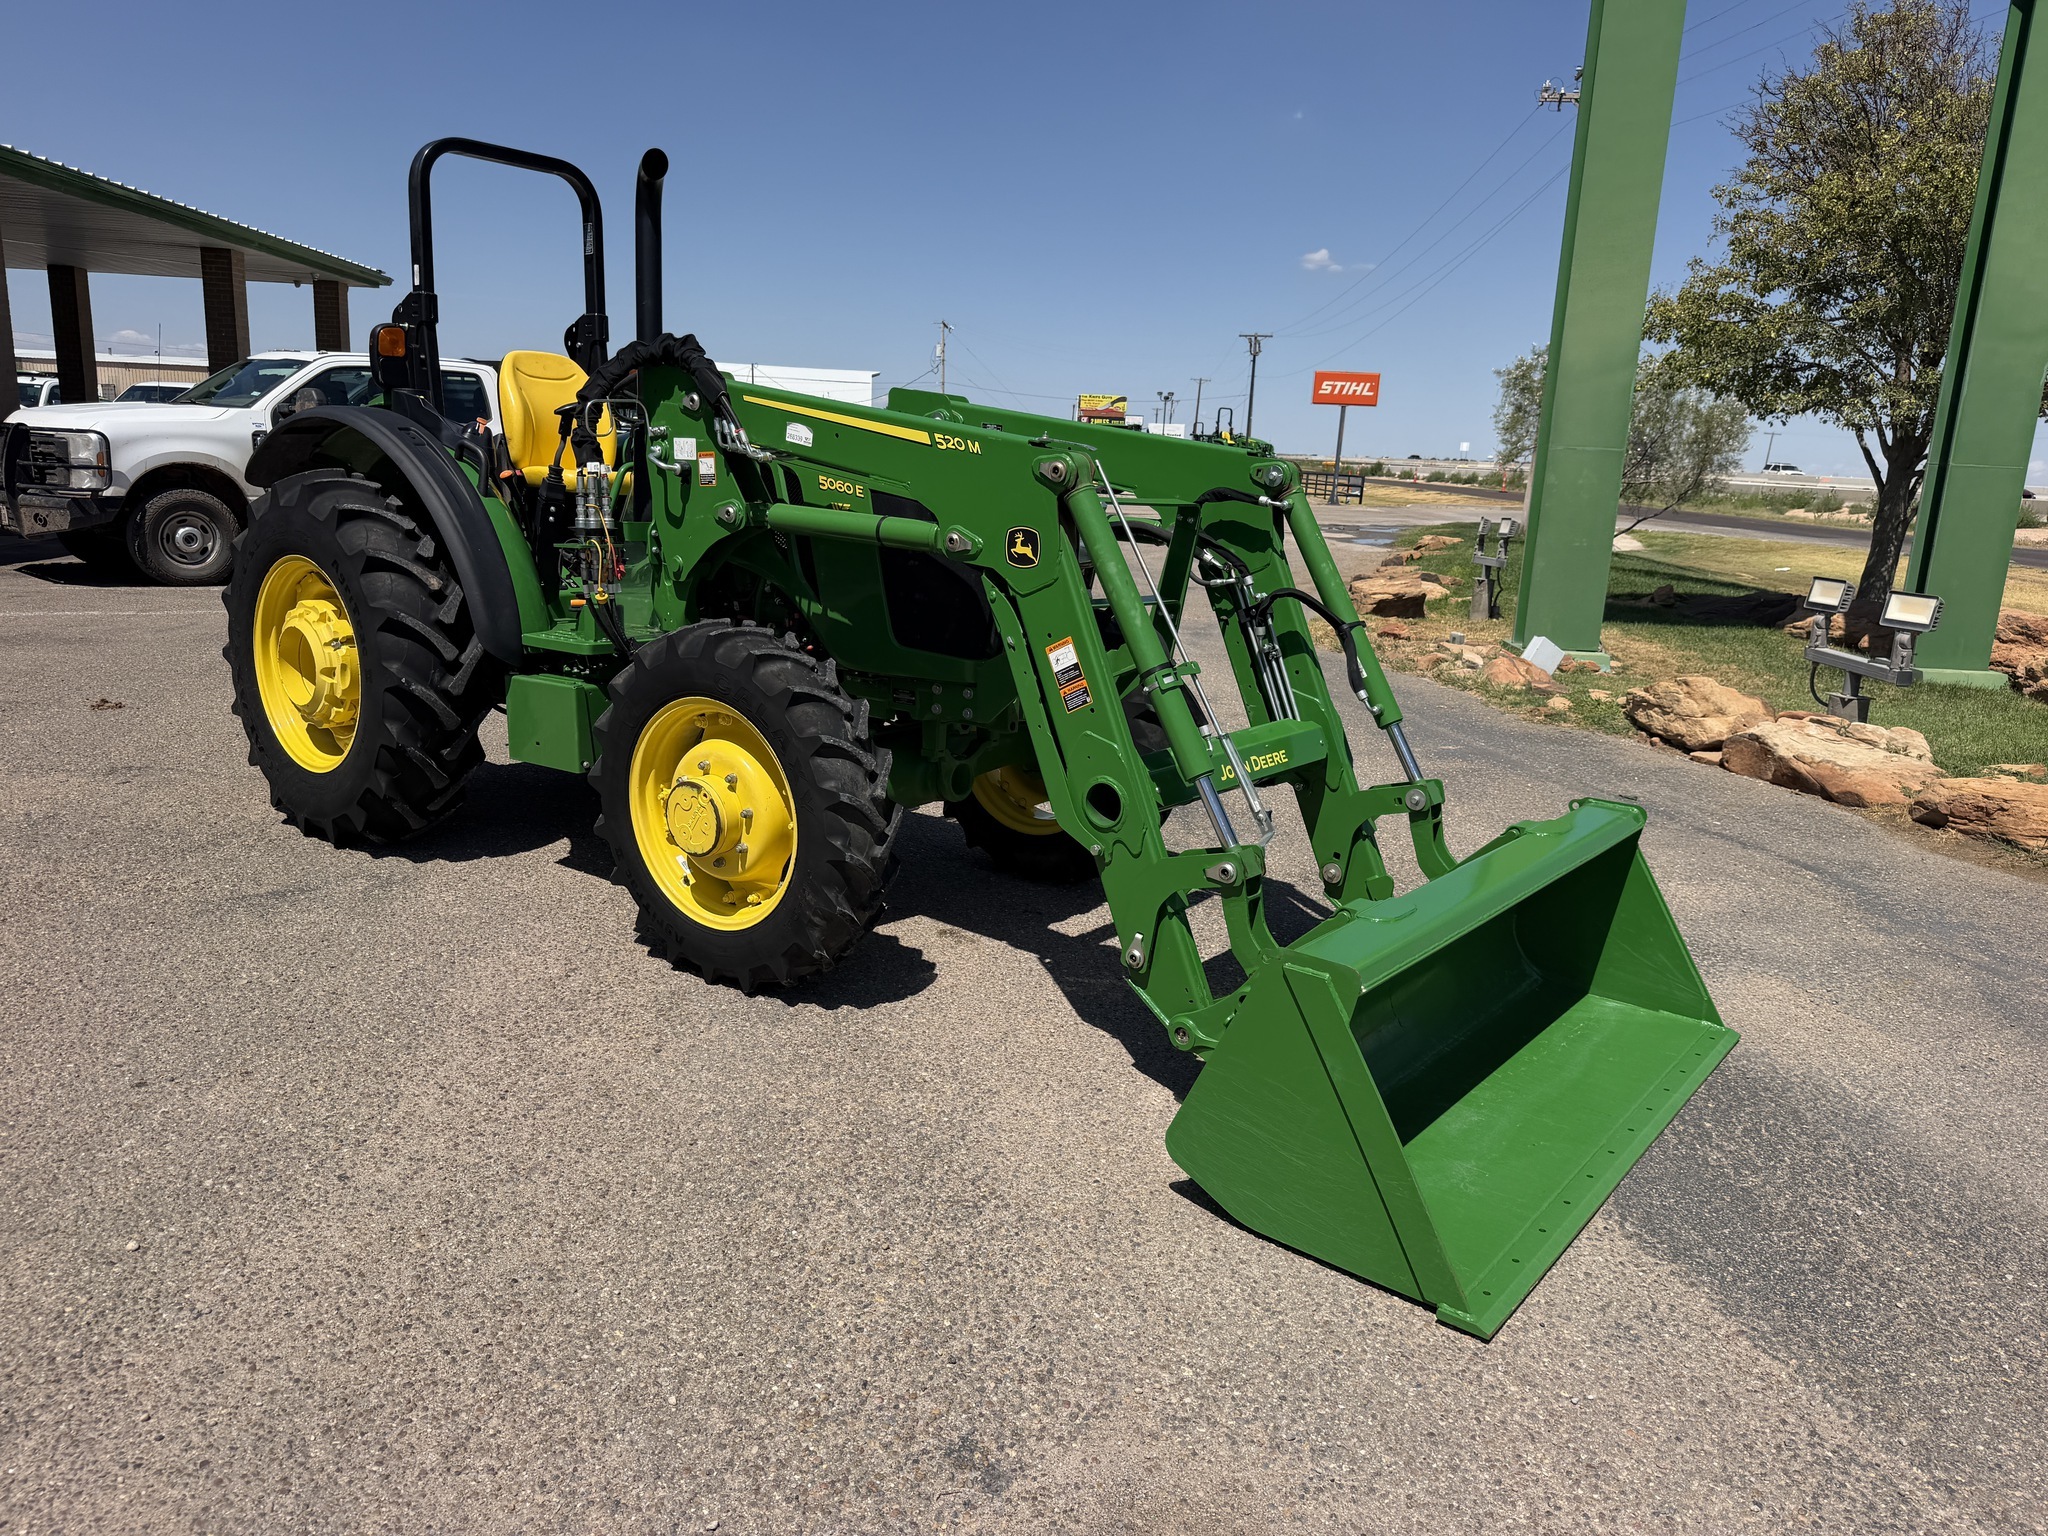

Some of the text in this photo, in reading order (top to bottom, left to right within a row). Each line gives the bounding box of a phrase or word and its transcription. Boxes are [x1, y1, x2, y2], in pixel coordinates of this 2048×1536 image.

[1318, 381, 1375, 396] STIHL
[933, 432, 982, 455] 520 M
[818, 475, 865, 498] 5060 E
[714, 672, 816, 816] GALAXY
[1220, 749, 1289, 781] JON DEERE
